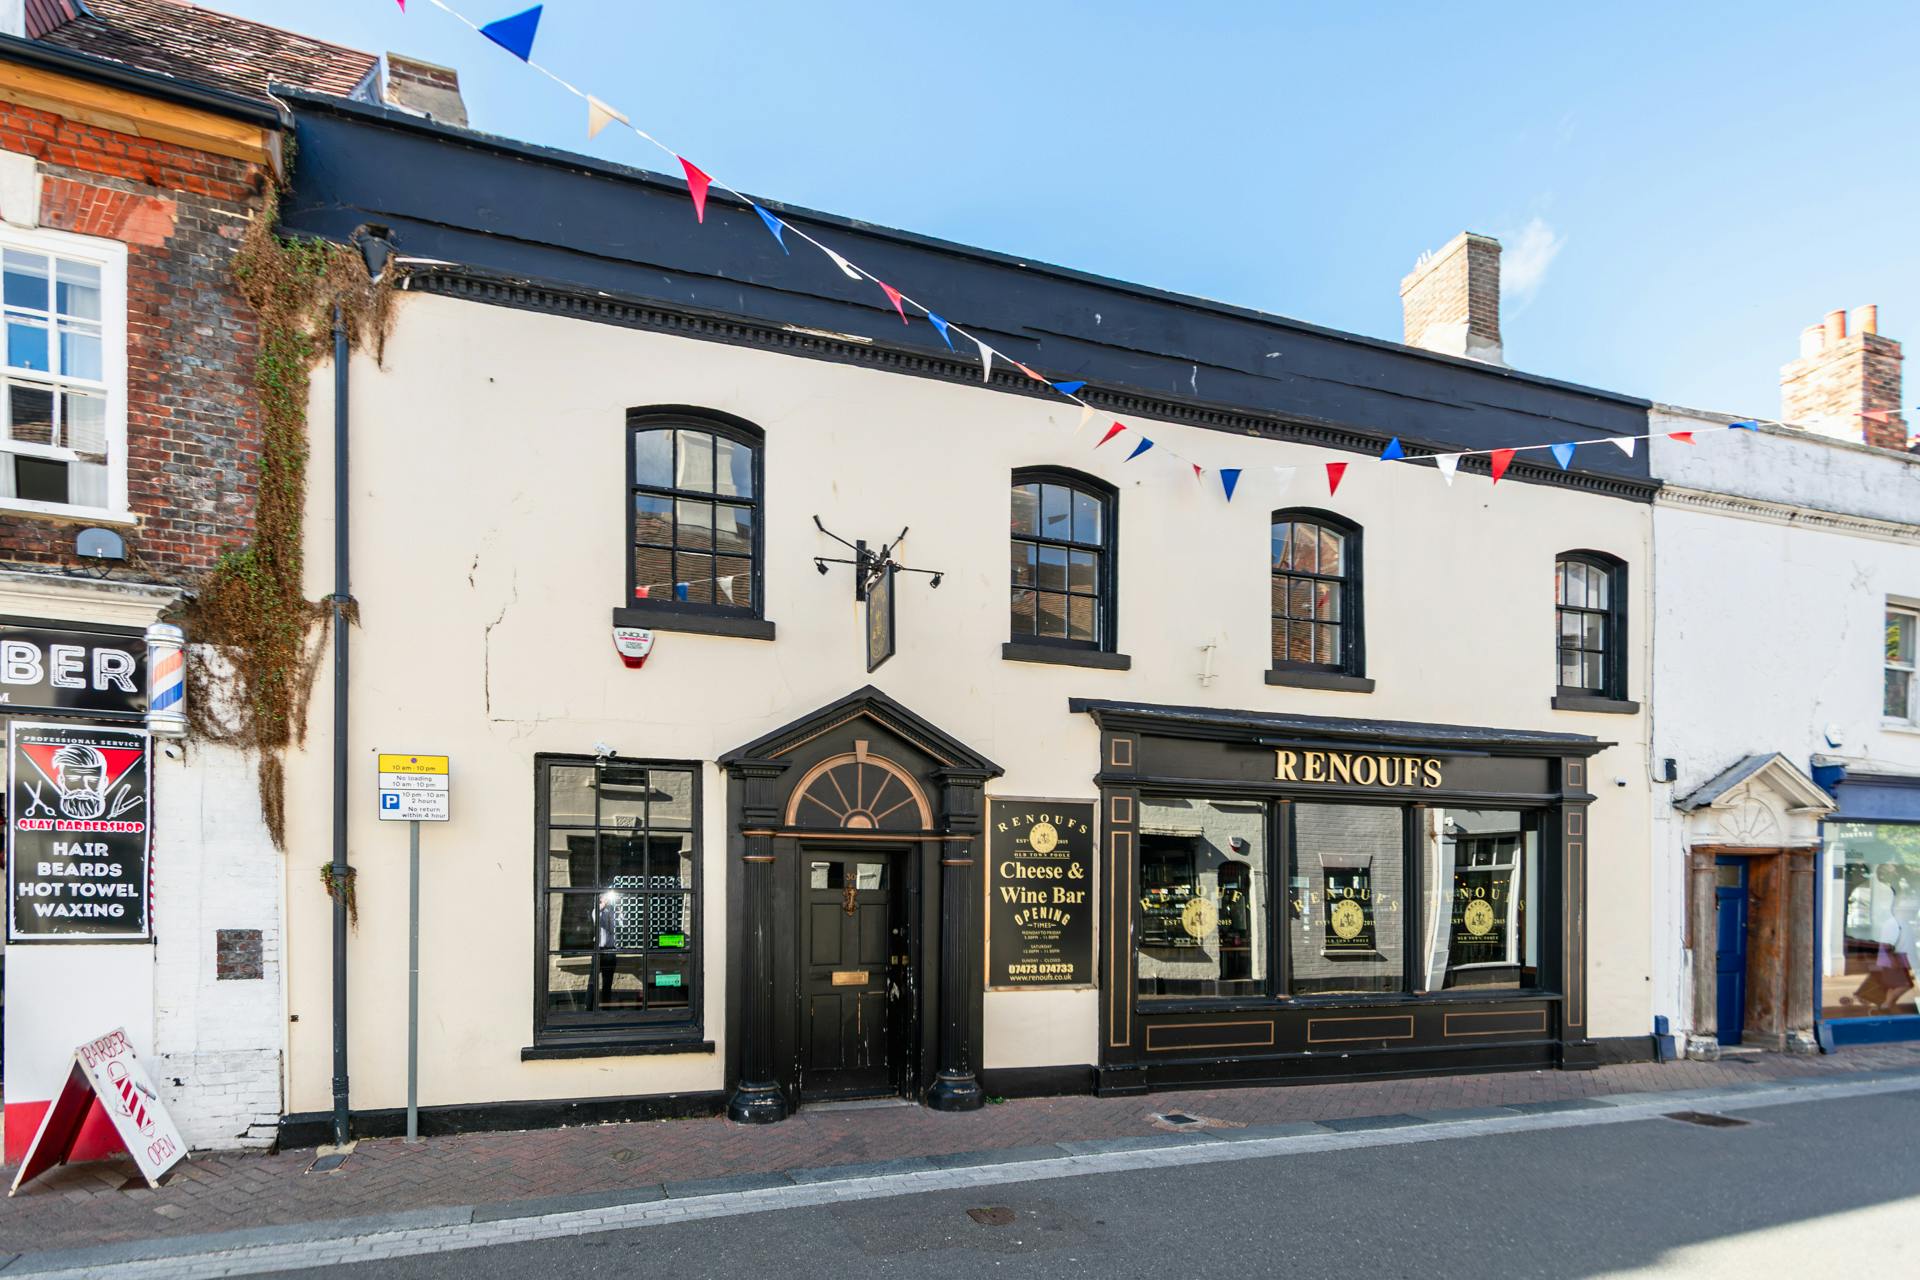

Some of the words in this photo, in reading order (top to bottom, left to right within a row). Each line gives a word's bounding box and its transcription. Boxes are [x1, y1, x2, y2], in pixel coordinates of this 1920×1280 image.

[0, 640, 138, 693] BER
[23, 735, 97, 745] PROFESSIONAL
[100, 740, 140, 748] SERVICE
[1274, 750, 1442, 788] RENOUFS
[18, 818, 54, 831] QUAY
[55, 820, 145, 833] BARBERSHOP
[997, 813, 1088, 834] RENOUFS
[53, 842, 109, 856] HAIR
[37, 862, 122, 877] BEARDS
[1000, 861, 1063, 879] Cheese
[1067, 862, 1085, 879] &
[18, 882, 64, 897] HOT
[68, 883, 139, 898] TOWEL
[999, 886, 1048, 904] Wine
[1051, 886, 1086, 904] Bar
[1293, 887, 1399, 912] RENOUFS
[33, 903, 125, 918] WAXING
[1014, 906, 1071, 926] OPENING
[1008, 964, 1037, 974] 07473
[1039, 963, 1074, 973] 074733
[1009, 973, 1072, 981] www.renoufs.co.uk
[80, 1031, 133, 1068] BARBER
[147, 1134, 177, 1166] OPEN
